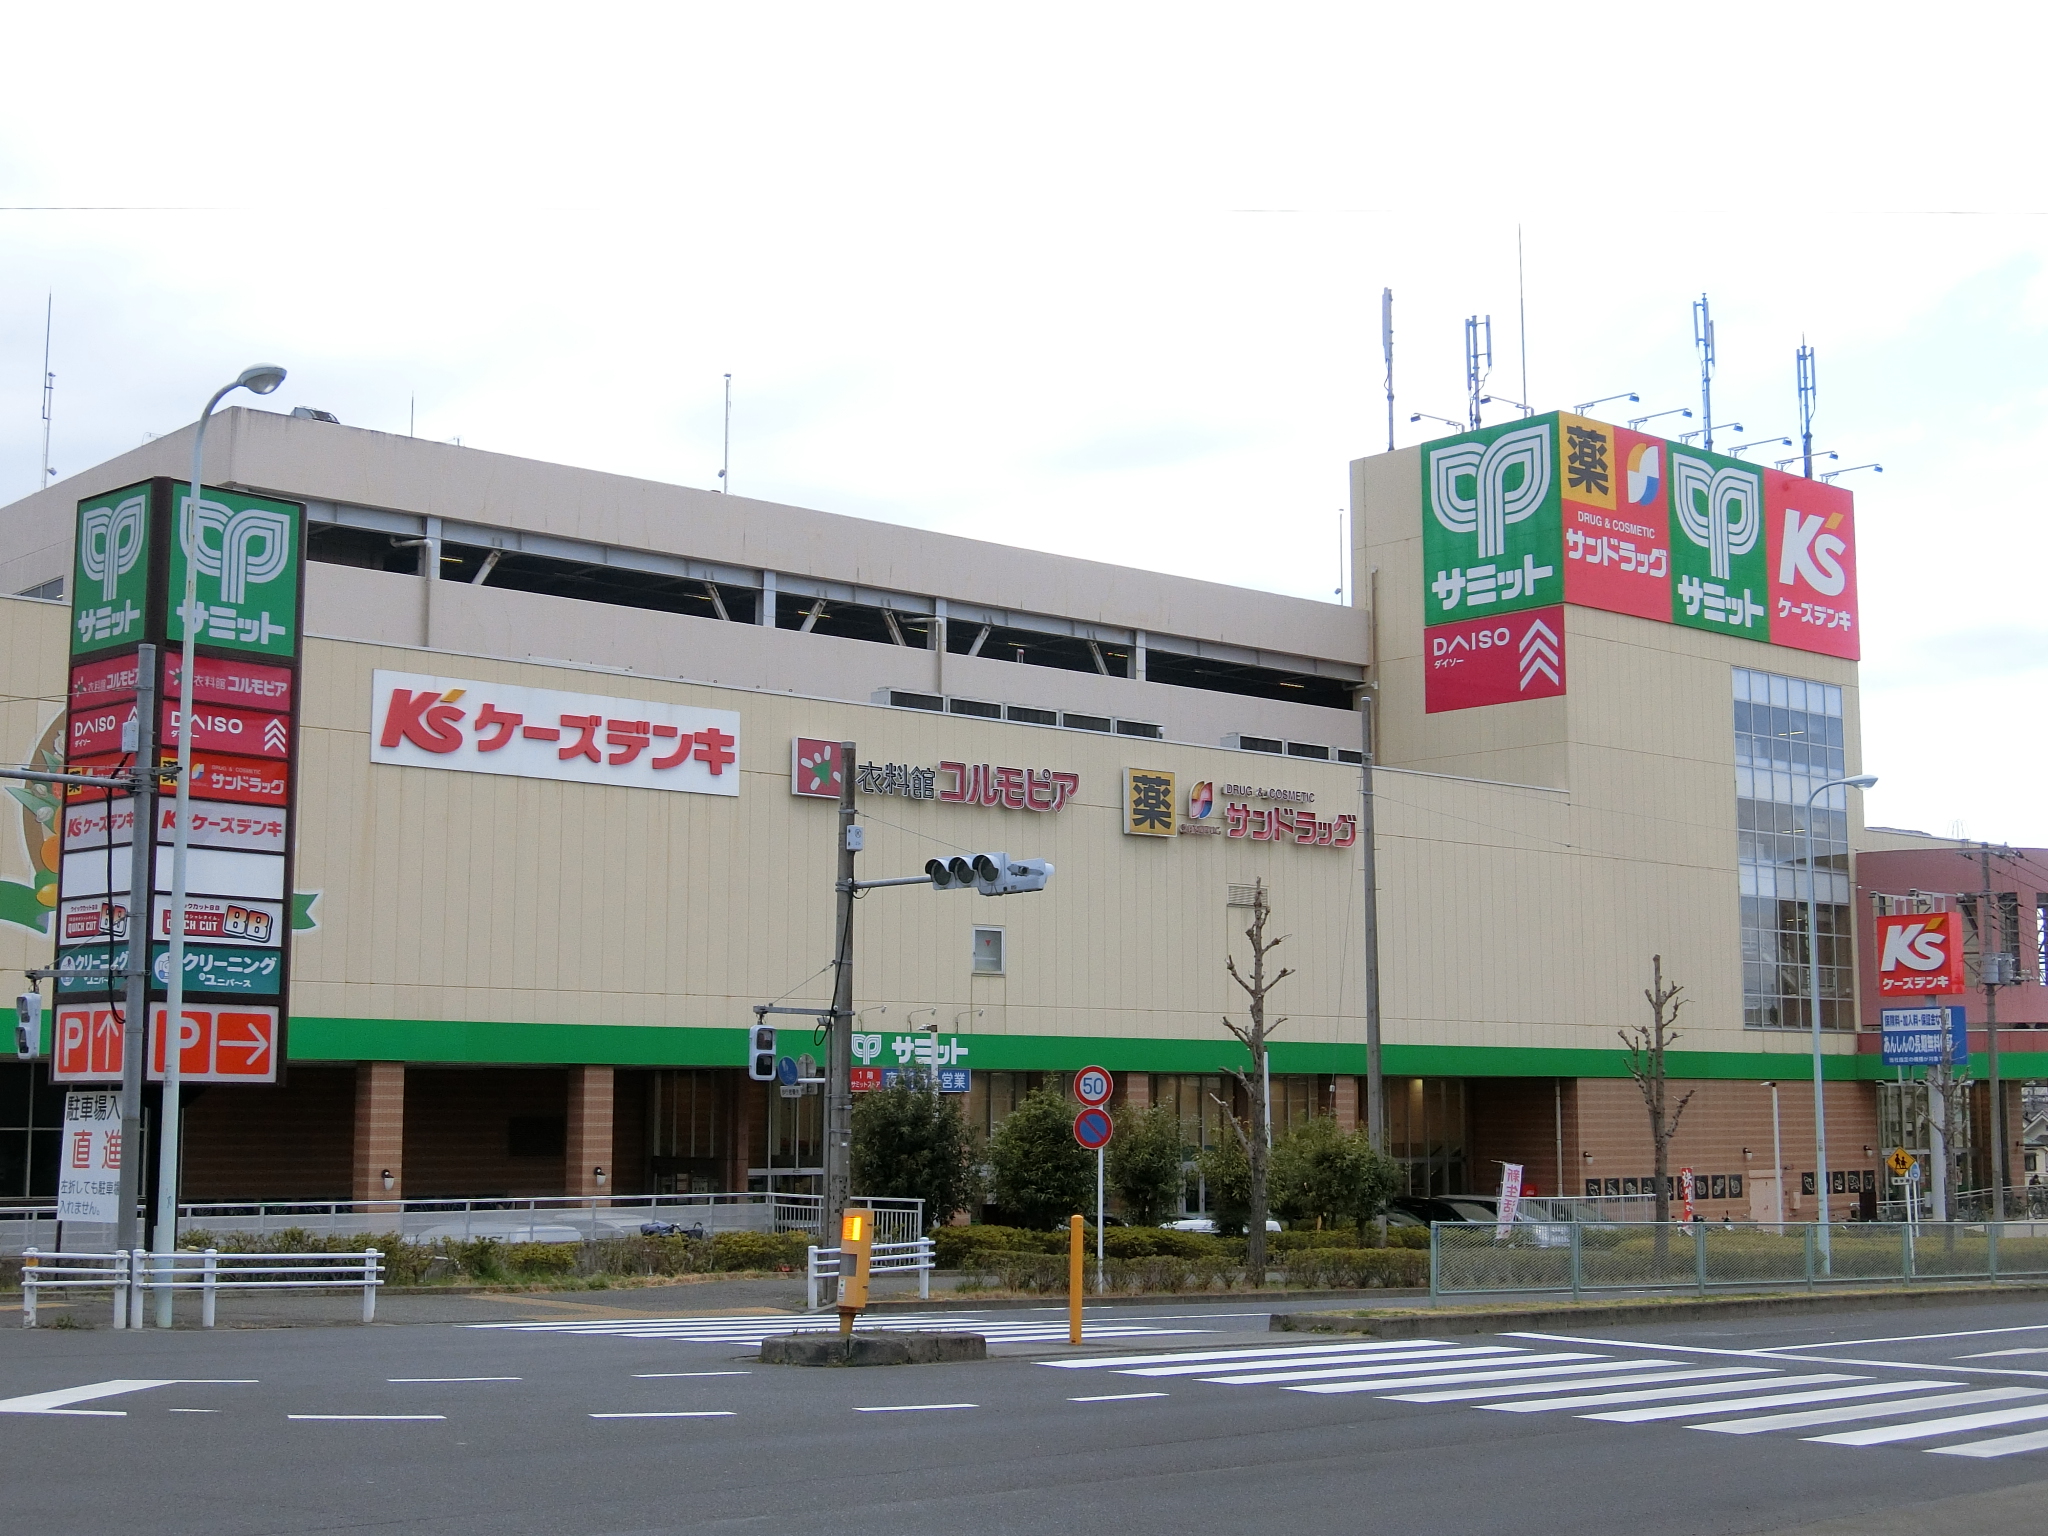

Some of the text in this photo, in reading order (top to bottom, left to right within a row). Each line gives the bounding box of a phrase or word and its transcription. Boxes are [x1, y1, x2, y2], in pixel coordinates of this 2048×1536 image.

[1567, 425, 1609, 496] 薬
[1578, 511, 1655, 539] DRUG & COSMETIC
[1566, 528, 1667, 578] サンドラッグ
[1432, 554, 1553, 611] サミット
[1678, 574, 1764, 627] サミット
[1778, 597, 1851, 631] ケーズデンキ
[78, 599, 140, 643] サミット
[176, 599, 286, 645] サミット
[1433, 627, 1510, 656] DAISO
[1433, 658, 1464, 670] ダイソー
[193, 675, 288, 697] 衣料館 コルモピア
[75, 715, 116, 737] DAISO
[475, 703, 736, 776] ケーズデンキ
[211, 773, 285, 795] サンドラッグ
[856, 760, 1080, 813] 衣料館 コルモピア
[1225, 783, 1316, 804] DRUG & COSMETIC
[1132, 775, 1172, 830] 薬
[192, 814, 283, 837] ケーズデンキ
[1226, 802, 1358, 848] サンドラッグ
[200, 921, 218, 932] CUT
[223, 904, 272, 941] BB
[183, 952, 277, 975] クリーニング
[1882, 976, 1949, 990] ケーズデンキ
[63, 1018, 84, 1067] P
[892, 1036, 968, 1065] サミット
[1082, 1077, 1104, 1095] 50
